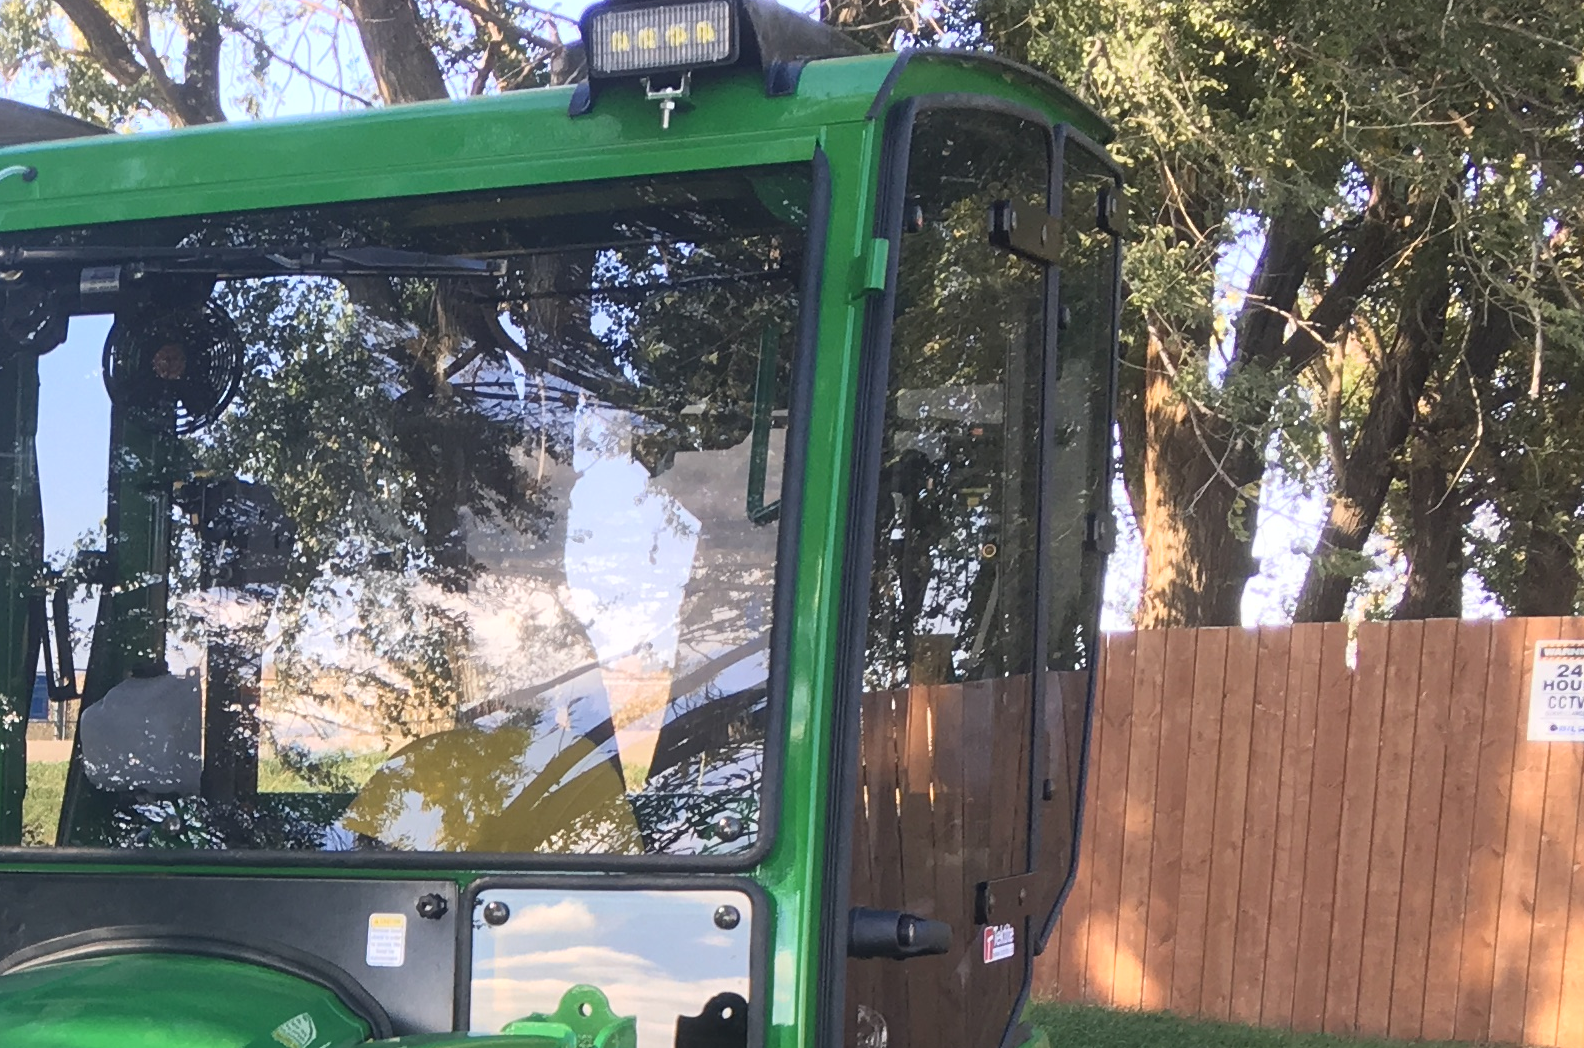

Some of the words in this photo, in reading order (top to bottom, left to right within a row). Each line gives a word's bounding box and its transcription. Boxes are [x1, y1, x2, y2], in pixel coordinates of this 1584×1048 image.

[1557, 664, 1583, 678] 24
[1543, 680, 1584, 691] HOU
[1548, 695, 1584, 709] CCTV
